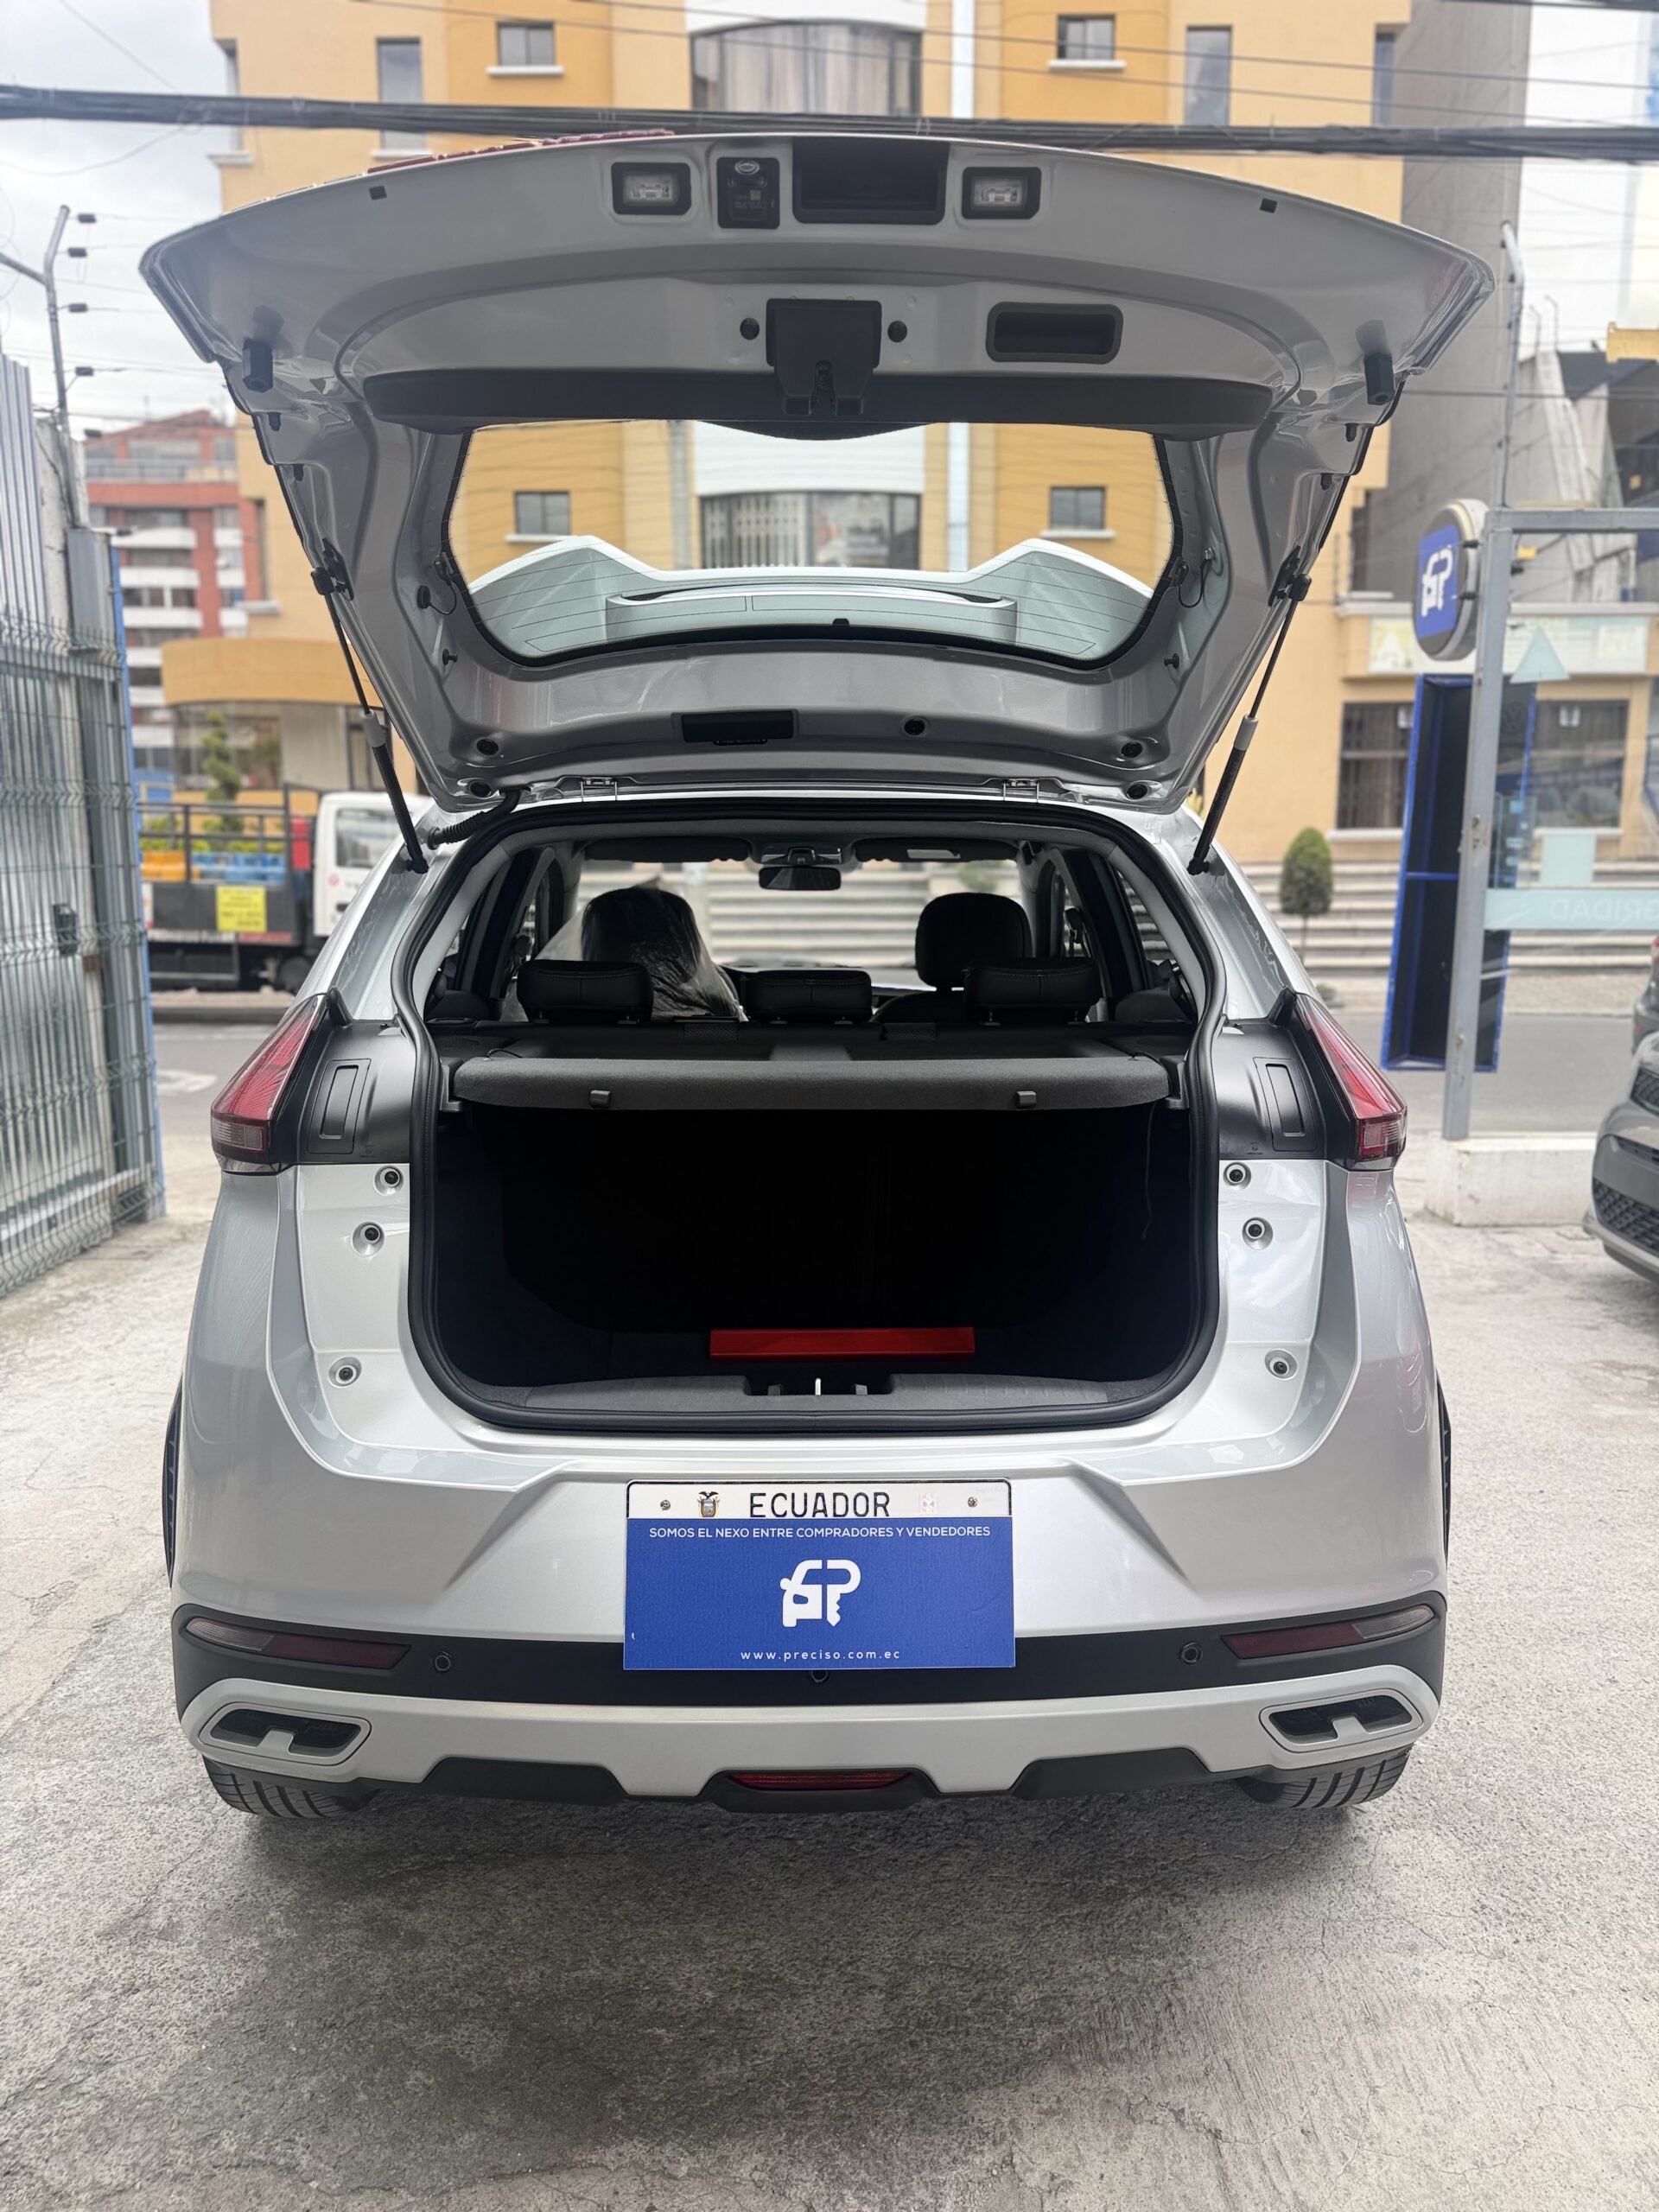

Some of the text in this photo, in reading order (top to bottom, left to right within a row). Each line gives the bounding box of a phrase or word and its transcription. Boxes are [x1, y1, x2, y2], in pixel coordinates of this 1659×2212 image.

[749, 1491, 890, 1518] ECUADOR
[649, 1526, 991, 1538] SOMOS EL NEXO ENTRE COMPRADORES Y VENDEDORES
[741, 1649, 900, 1662] www.preciso.com.ec
